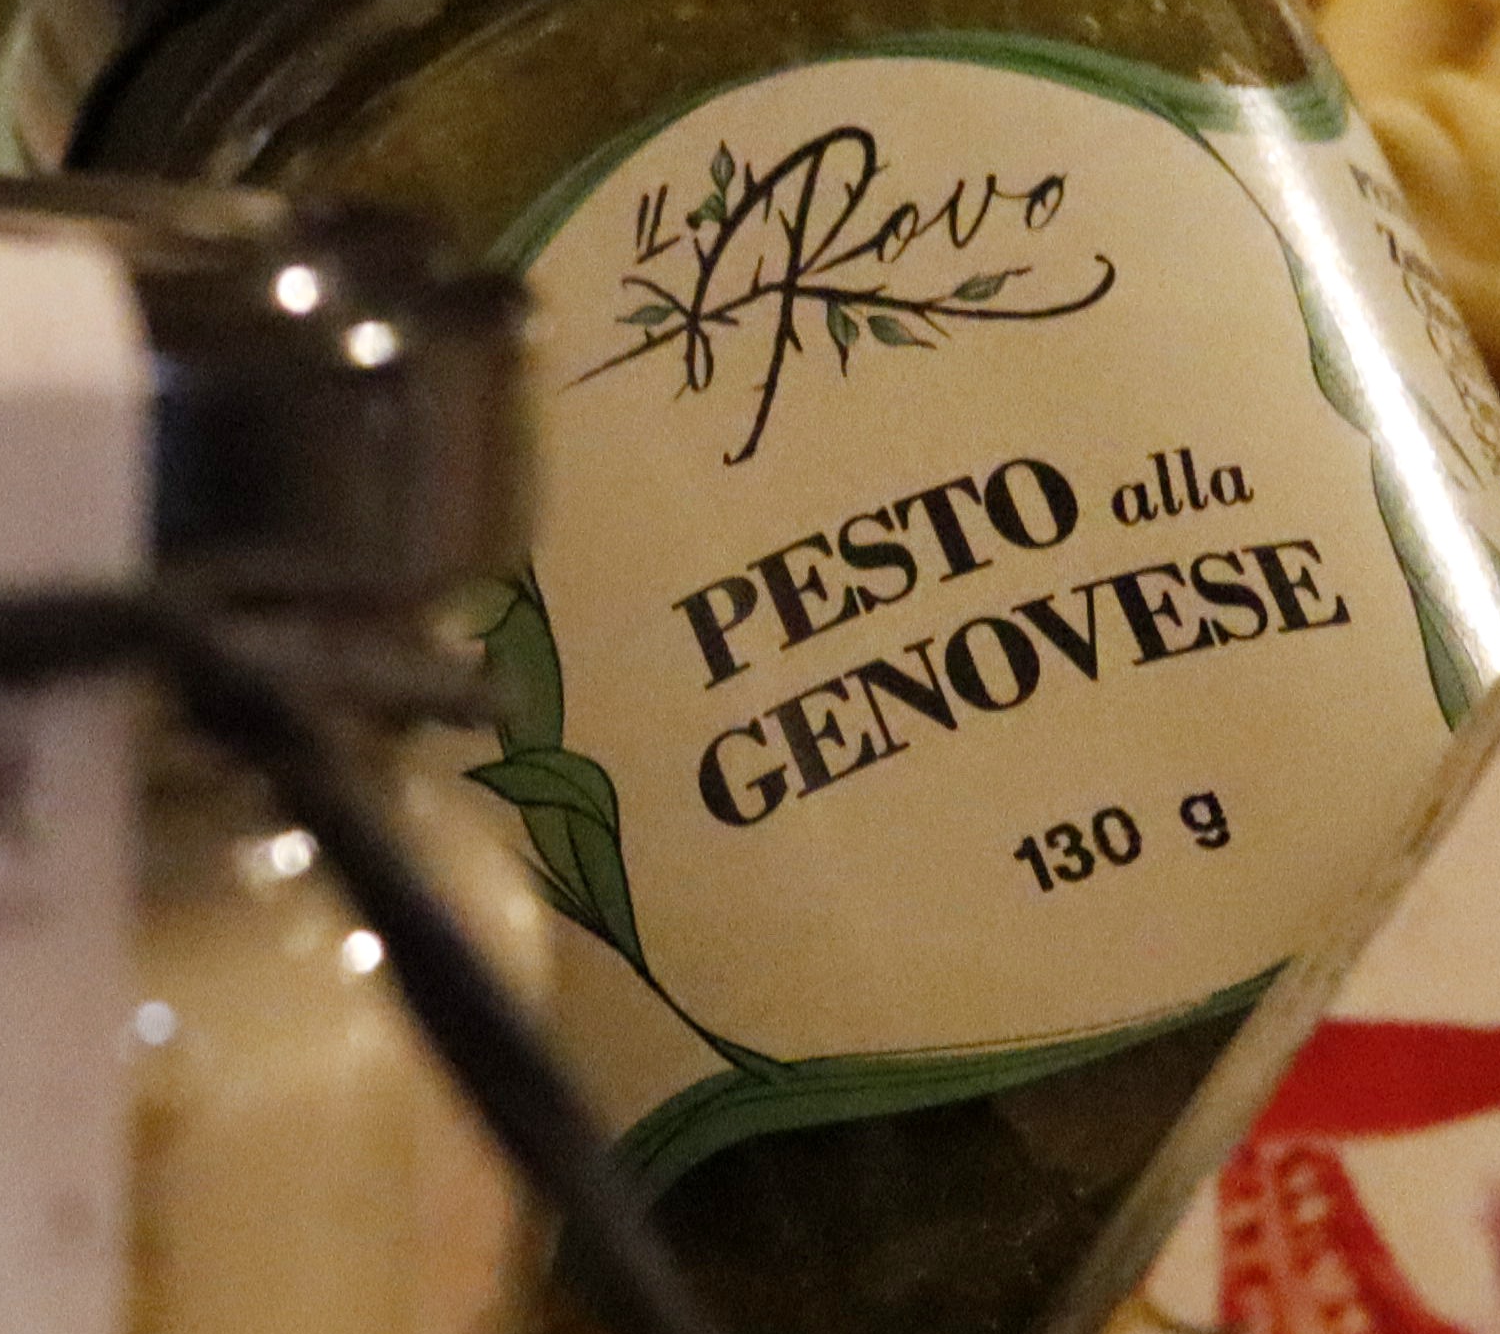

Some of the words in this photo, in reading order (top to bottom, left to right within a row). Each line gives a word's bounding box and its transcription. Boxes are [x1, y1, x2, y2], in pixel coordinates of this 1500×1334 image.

[672, 456, 1080, 689] PESTO
[1109, 447, 1256, 529] alla
[696, 539, 1352, 827] GENOVESE
[1012, 803, 1144, 894] 130
[1181, 789, 1234, 851] g
